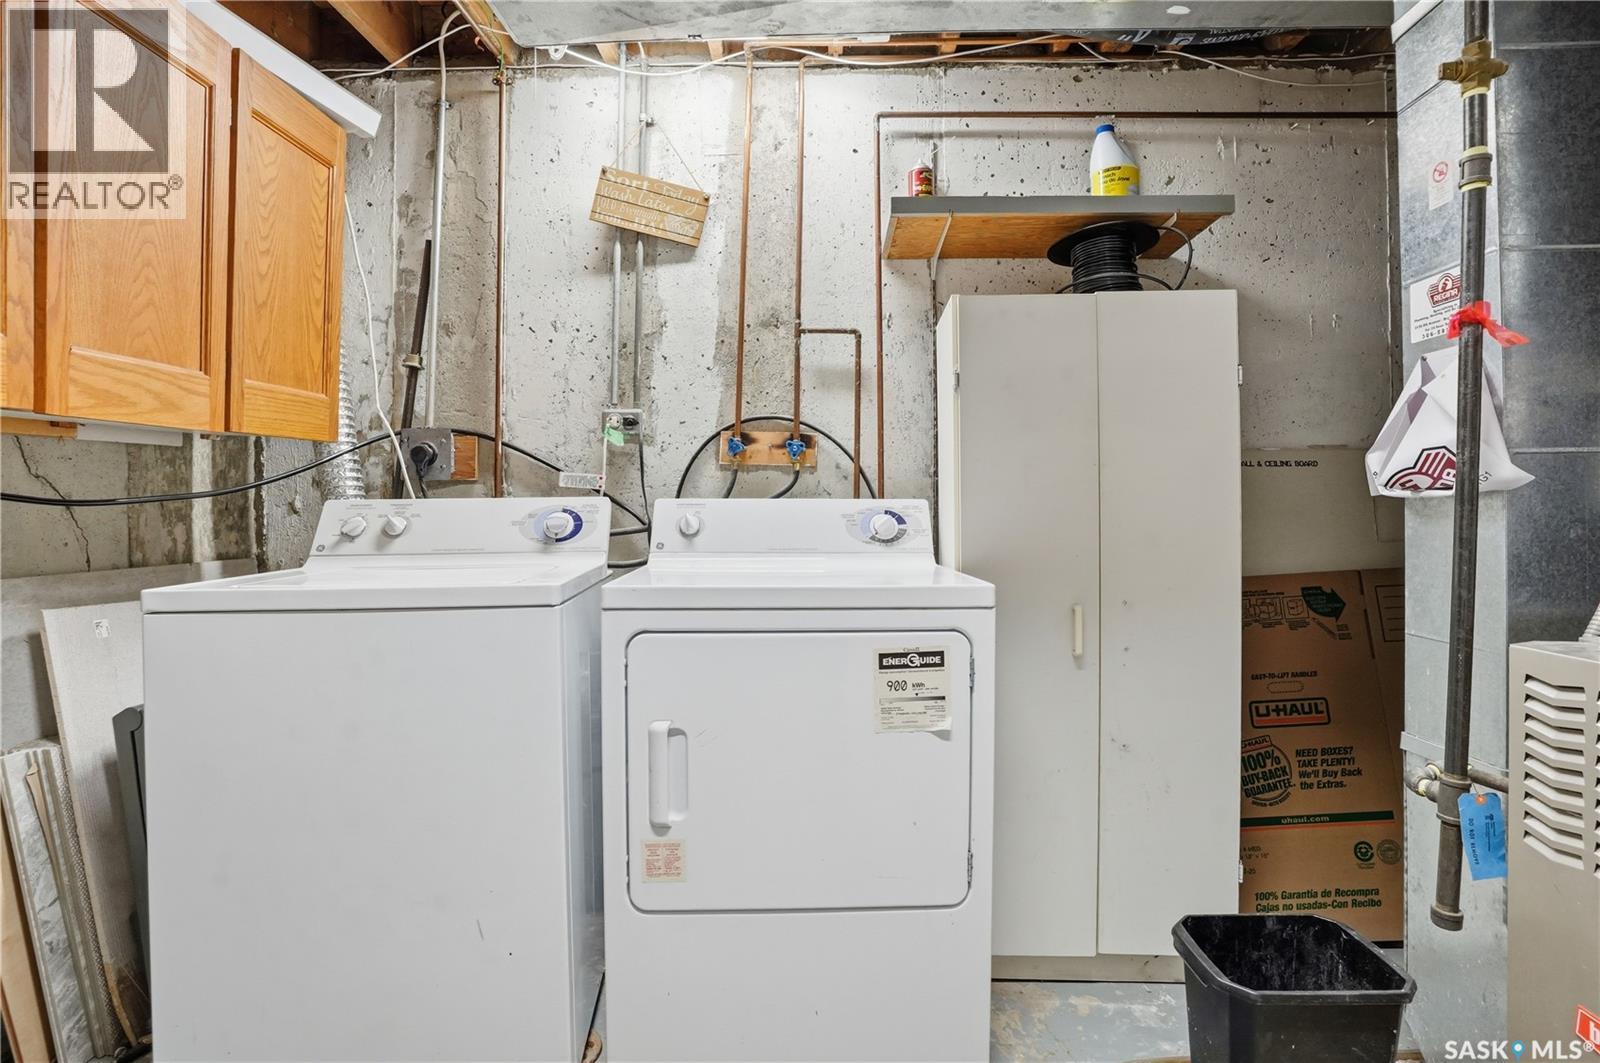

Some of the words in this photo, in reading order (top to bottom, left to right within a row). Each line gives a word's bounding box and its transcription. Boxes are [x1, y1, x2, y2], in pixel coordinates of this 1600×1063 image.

[606, 169, 650, 190] Sort
[600, 183, 632, 202] Wash
[886, 680, 908, 692] 900
[1296, 748, 1318, 758] NEED
[1321, 746, 1354, 757] BOXES?
[1297, 759, 1318, 768] TAKE
[1321, 757, 1356, 767] PLENTY!
[1299, 769, 1320, 779] We'll
[1322, 769, 1338, 779] Buy
[1341, 767, 1363, 777] Back
[1300, 781, 1314, 790] the
[1317, 780, 1347, 790] Extras.
[1281, 815, 1330, 825] uhaul.com
[1468, 818, 1475, 827] DO
[1255, 890, 1279, 901] 100%
[1321, 888, 1332, 898] de
[1335, 886, 1380, 900] Recompra
[1256, 903, 1280, 914] Cajas
[1282, 903, 1293, 911] no
[1296, 900, 1348, 910] usadas-Con
[1351, 899, 1382, 908] Recibo
